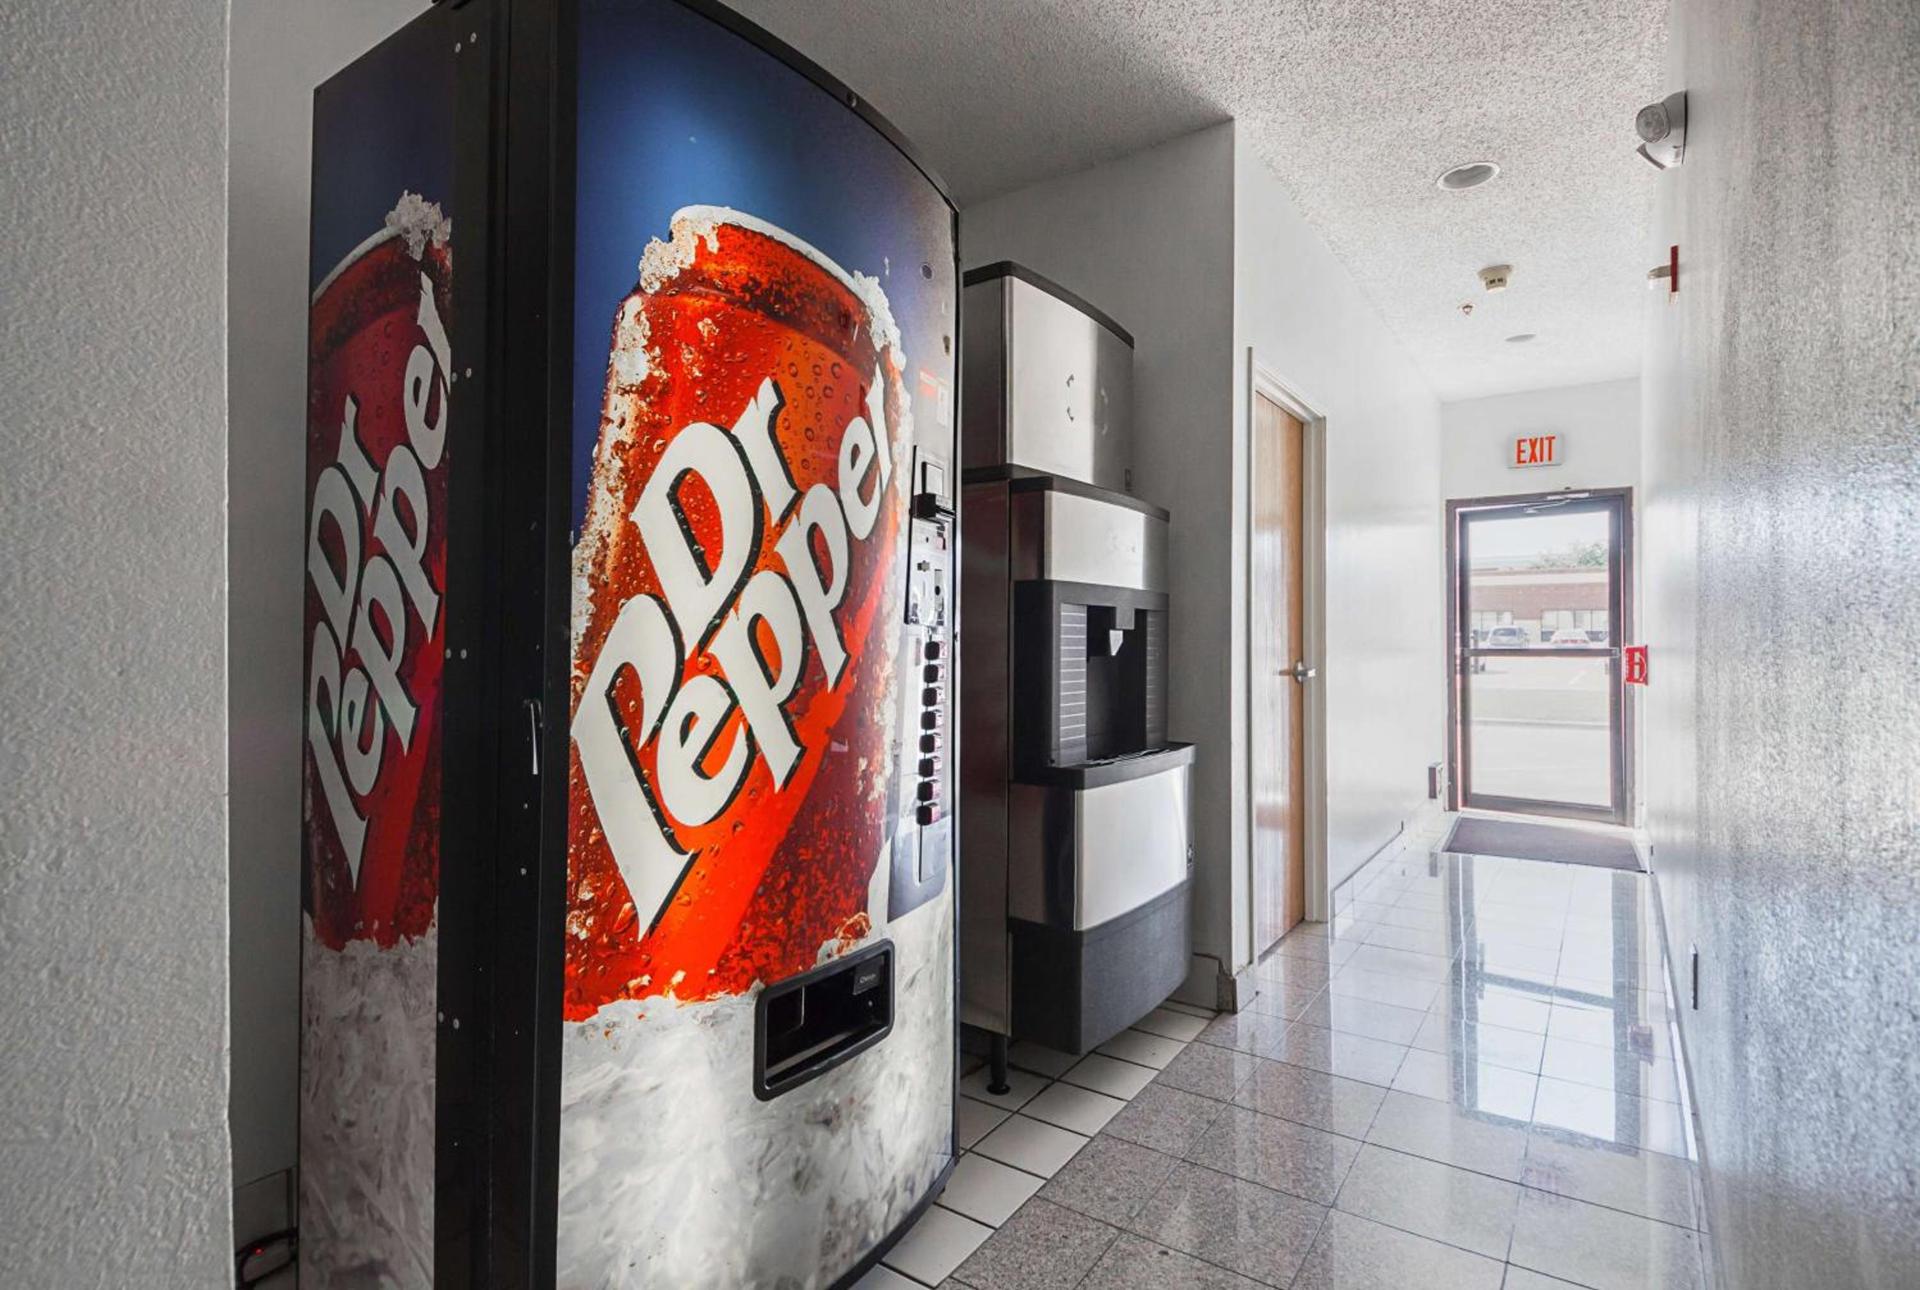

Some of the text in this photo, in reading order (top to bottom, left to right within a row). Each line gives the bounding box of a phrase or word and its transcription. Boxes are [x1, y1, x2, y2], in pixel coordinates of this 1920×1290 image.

[308, 395, 379, 658] Dr
[308, 271, 451, 892] Pepper
[631, 376, 799, 659] Dr
[1516, 435, 1556, 464] EXIT
[571, 362, 893, 941] Pepper
